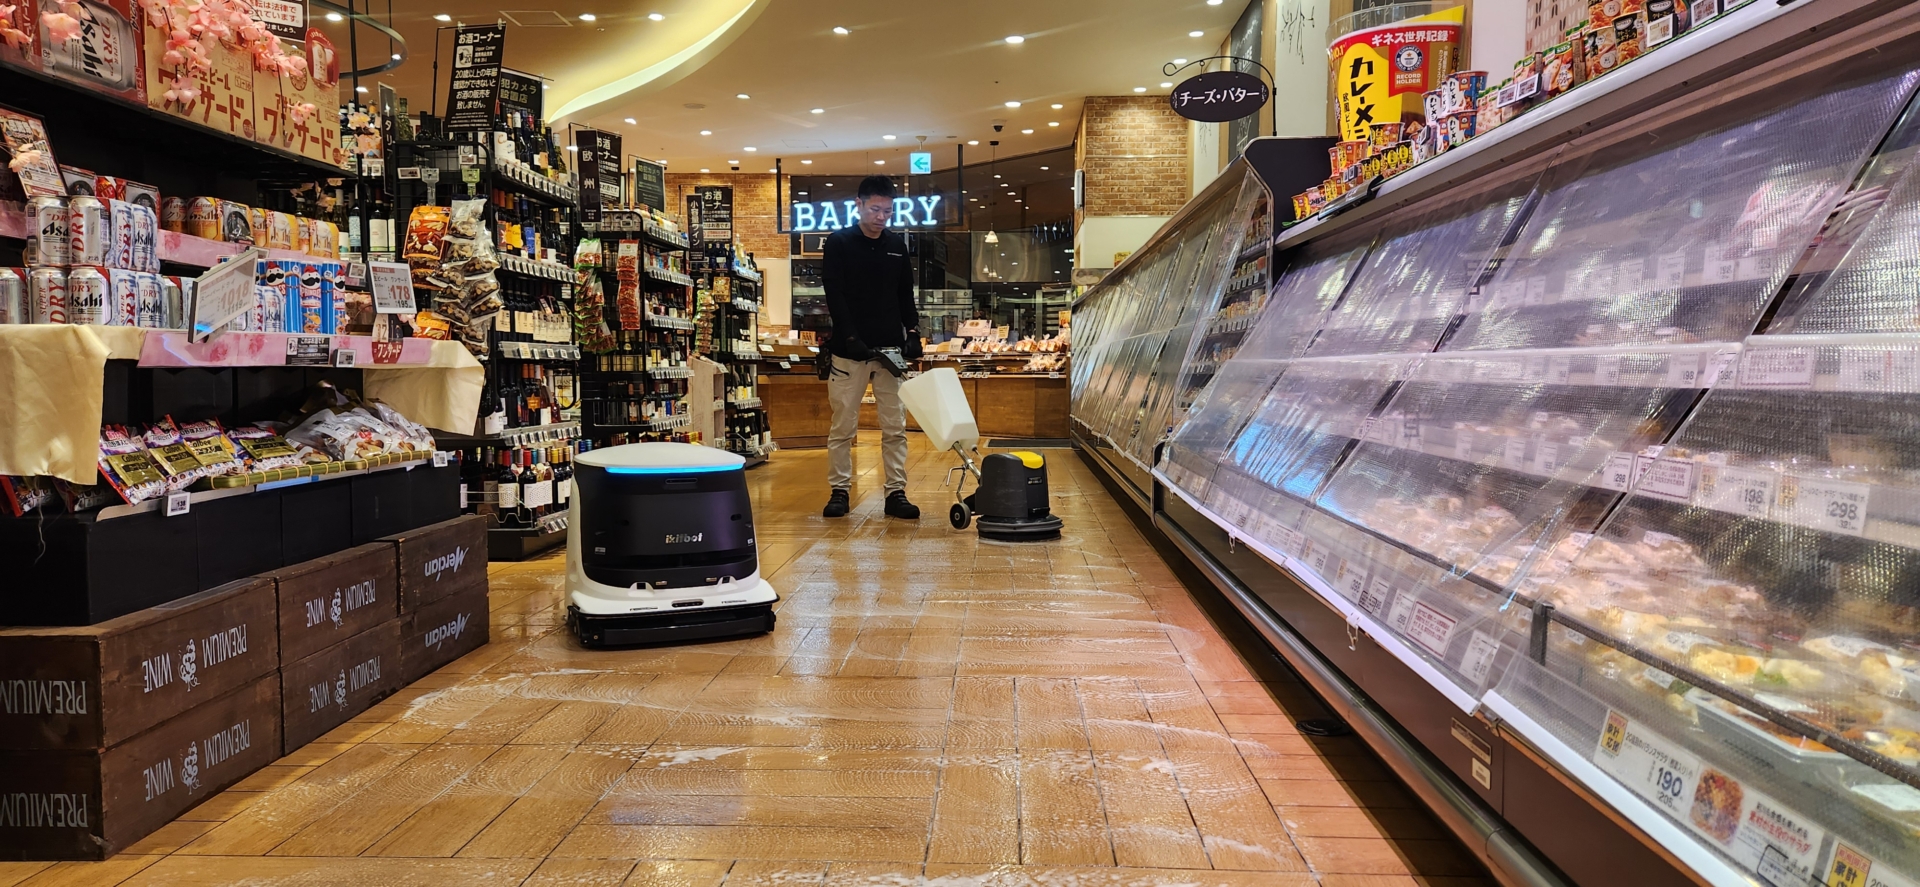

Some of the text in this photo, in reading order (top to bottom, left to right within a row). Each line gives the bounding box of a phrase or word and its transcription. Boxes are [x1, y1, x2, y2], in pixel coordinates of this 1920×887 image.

[78, 1, 103, 78] Asahi
[265, 23, 297, 34] りましょう。
[459, 32, 501, 44] お酒コーナー
[500, 77, 537, 94] 犯カメラ
[1180, 87, 1260, 107] チーズ・バター
[598, 150, 618, 160] ーナー
[582, 150, 596, 190] 欧州
[704, 190, 723, 201] お酒
[794, 195, 941, 231] BAKRY
[42, 222, 69, 236] Asa
[39, 286, 47, 316] SUPER
[220, 280, 250, 310] 1018
[390, 285, 410, 301] 178
[397, 300, 409, 308] 195
[377, 342, 402, 359] ワンサード
[1829, 501, 1858, 520] 298
[424, 546, 469, 582] Mercian
[305, 579, 376, 628] PREMIUM WINE
[425, 613, 471, 651] Mercian
[142, 624, 247, 693] PREMIUM WINE
[309, 656, 381, 713] PREMIUM WINE
[143, 719, 250, 802] PREMIUM WINE
[1656, 766, 1683, 797] 190
[1658, 791, 1673, 809] 205
[1833, 860, 1858, 885] 家計
